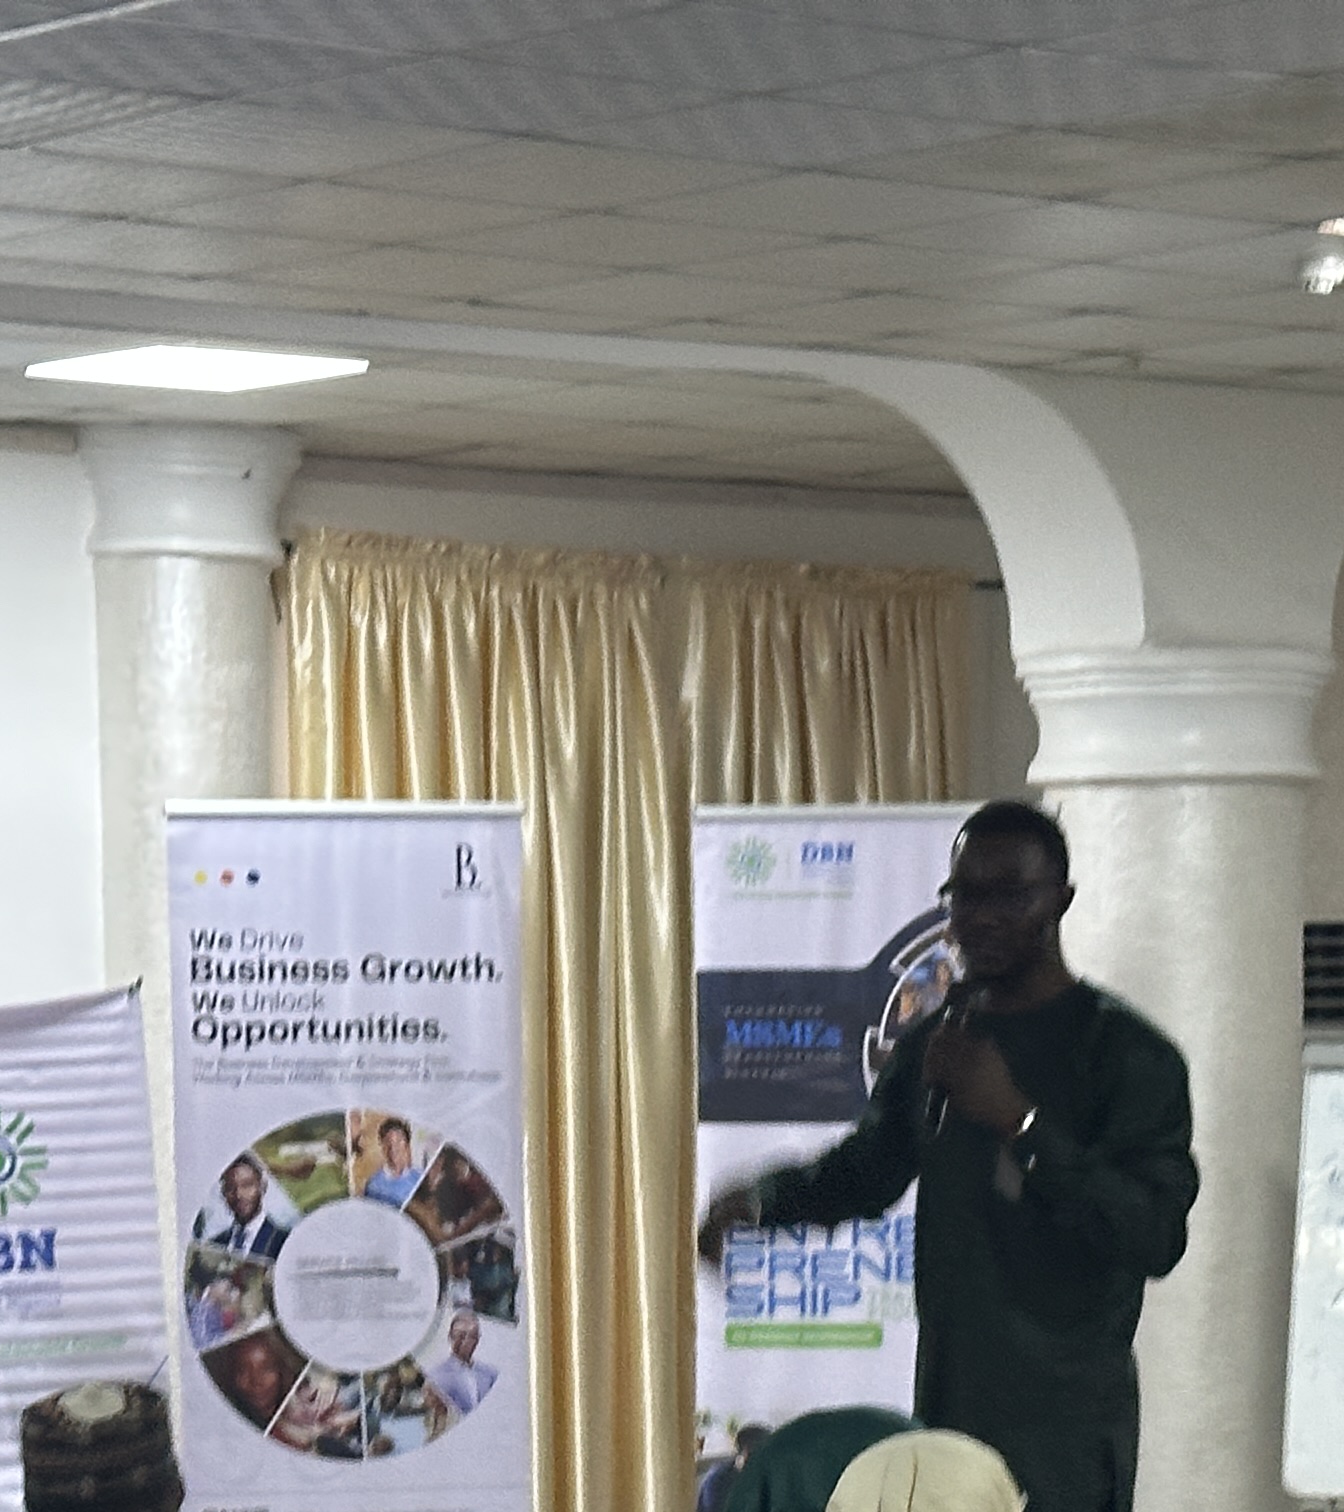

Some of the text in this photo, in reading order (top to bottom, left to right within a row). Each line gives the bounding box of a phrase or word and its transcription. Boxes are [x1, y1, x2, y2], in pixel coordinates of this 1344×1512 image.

[190, 928, 304, 951] We Drive
[190, 953, 350, 984] Business
[192, 989, 325, 1013] We Unlock
